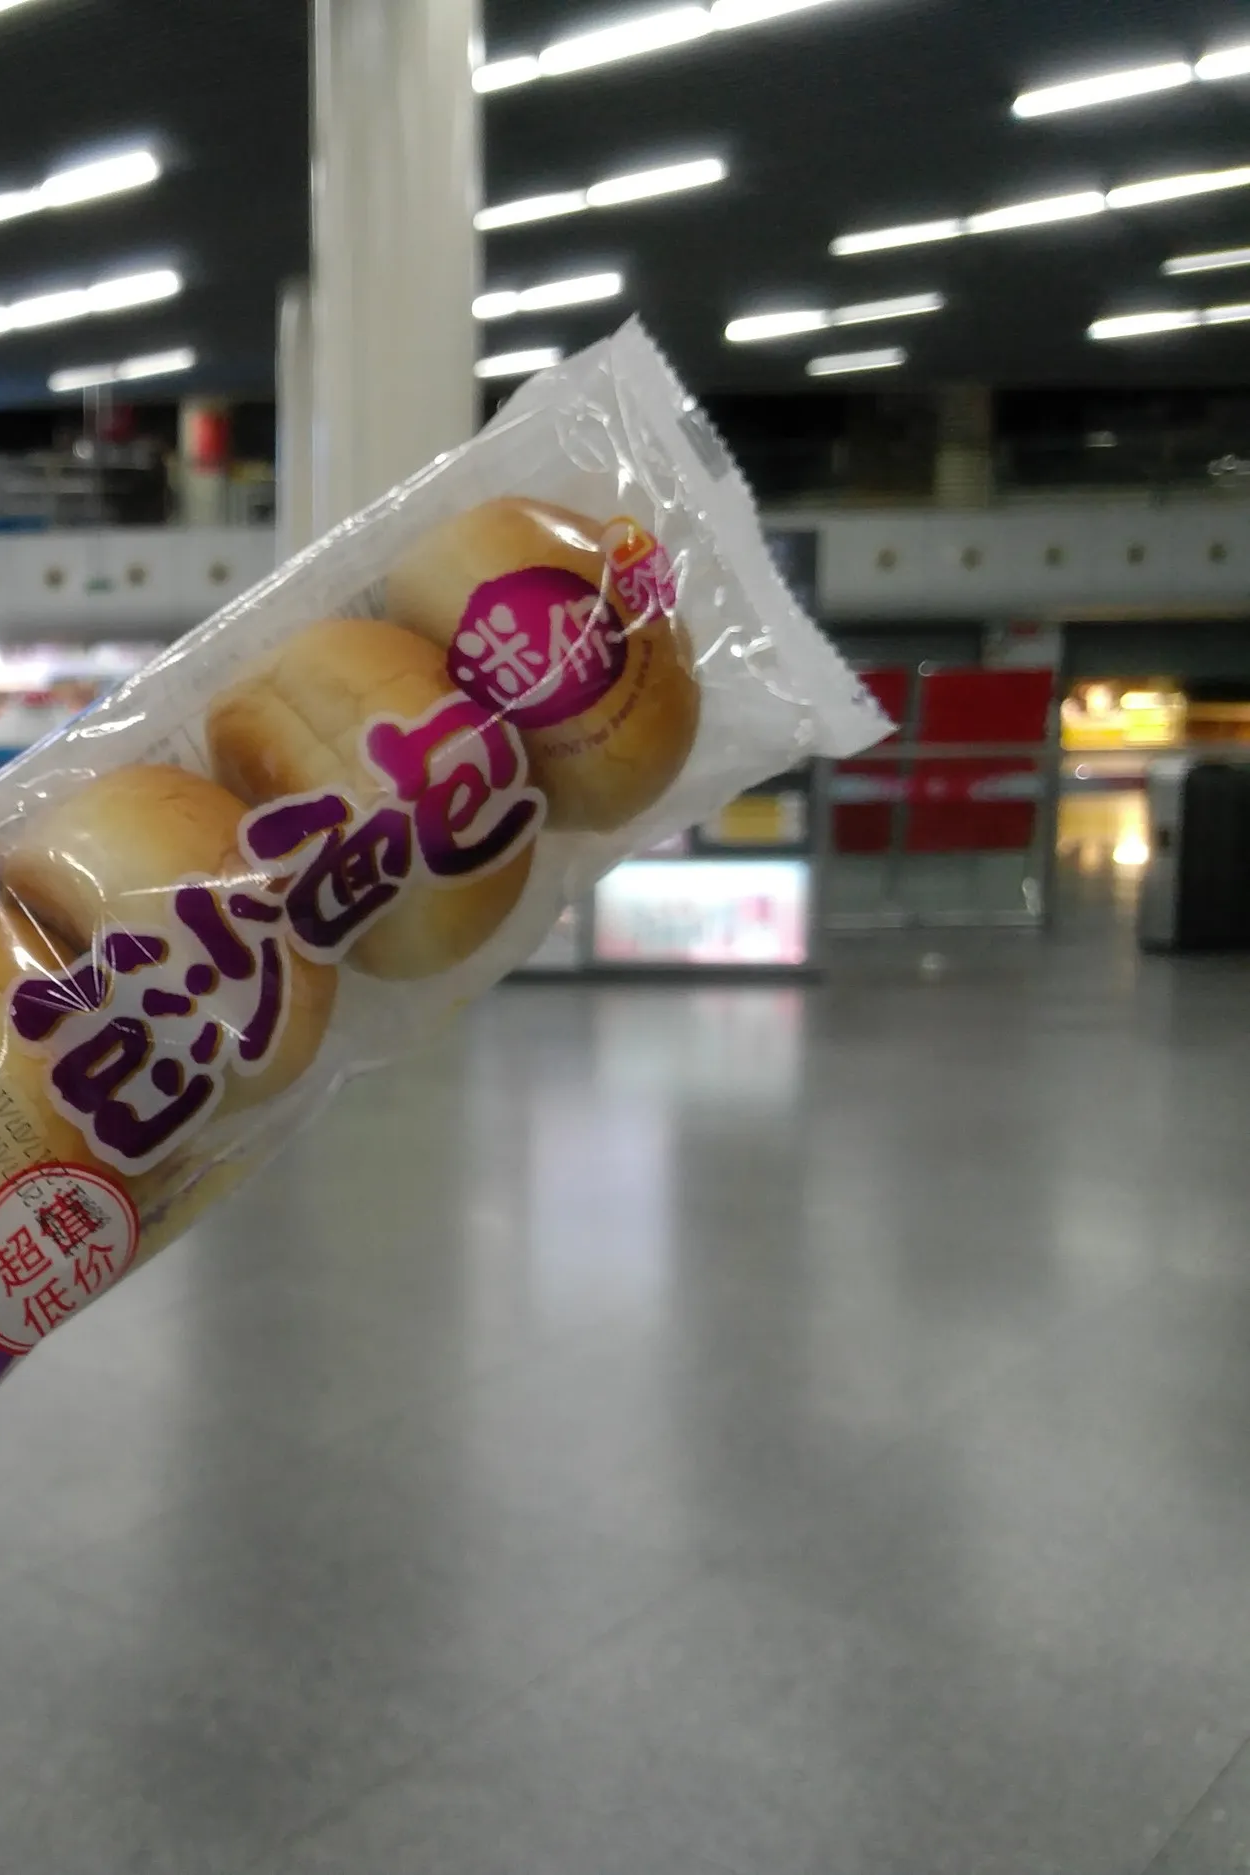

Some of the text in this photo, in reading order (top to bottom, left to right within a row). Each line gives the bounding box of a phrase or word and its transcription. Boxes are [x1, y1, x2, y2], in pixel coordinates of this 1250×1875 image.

[456, 594, 623, 711] 迷你
[10, 703, 539, 1159] 豆沙面包
[23, 1244, 115, 1338] 低价
